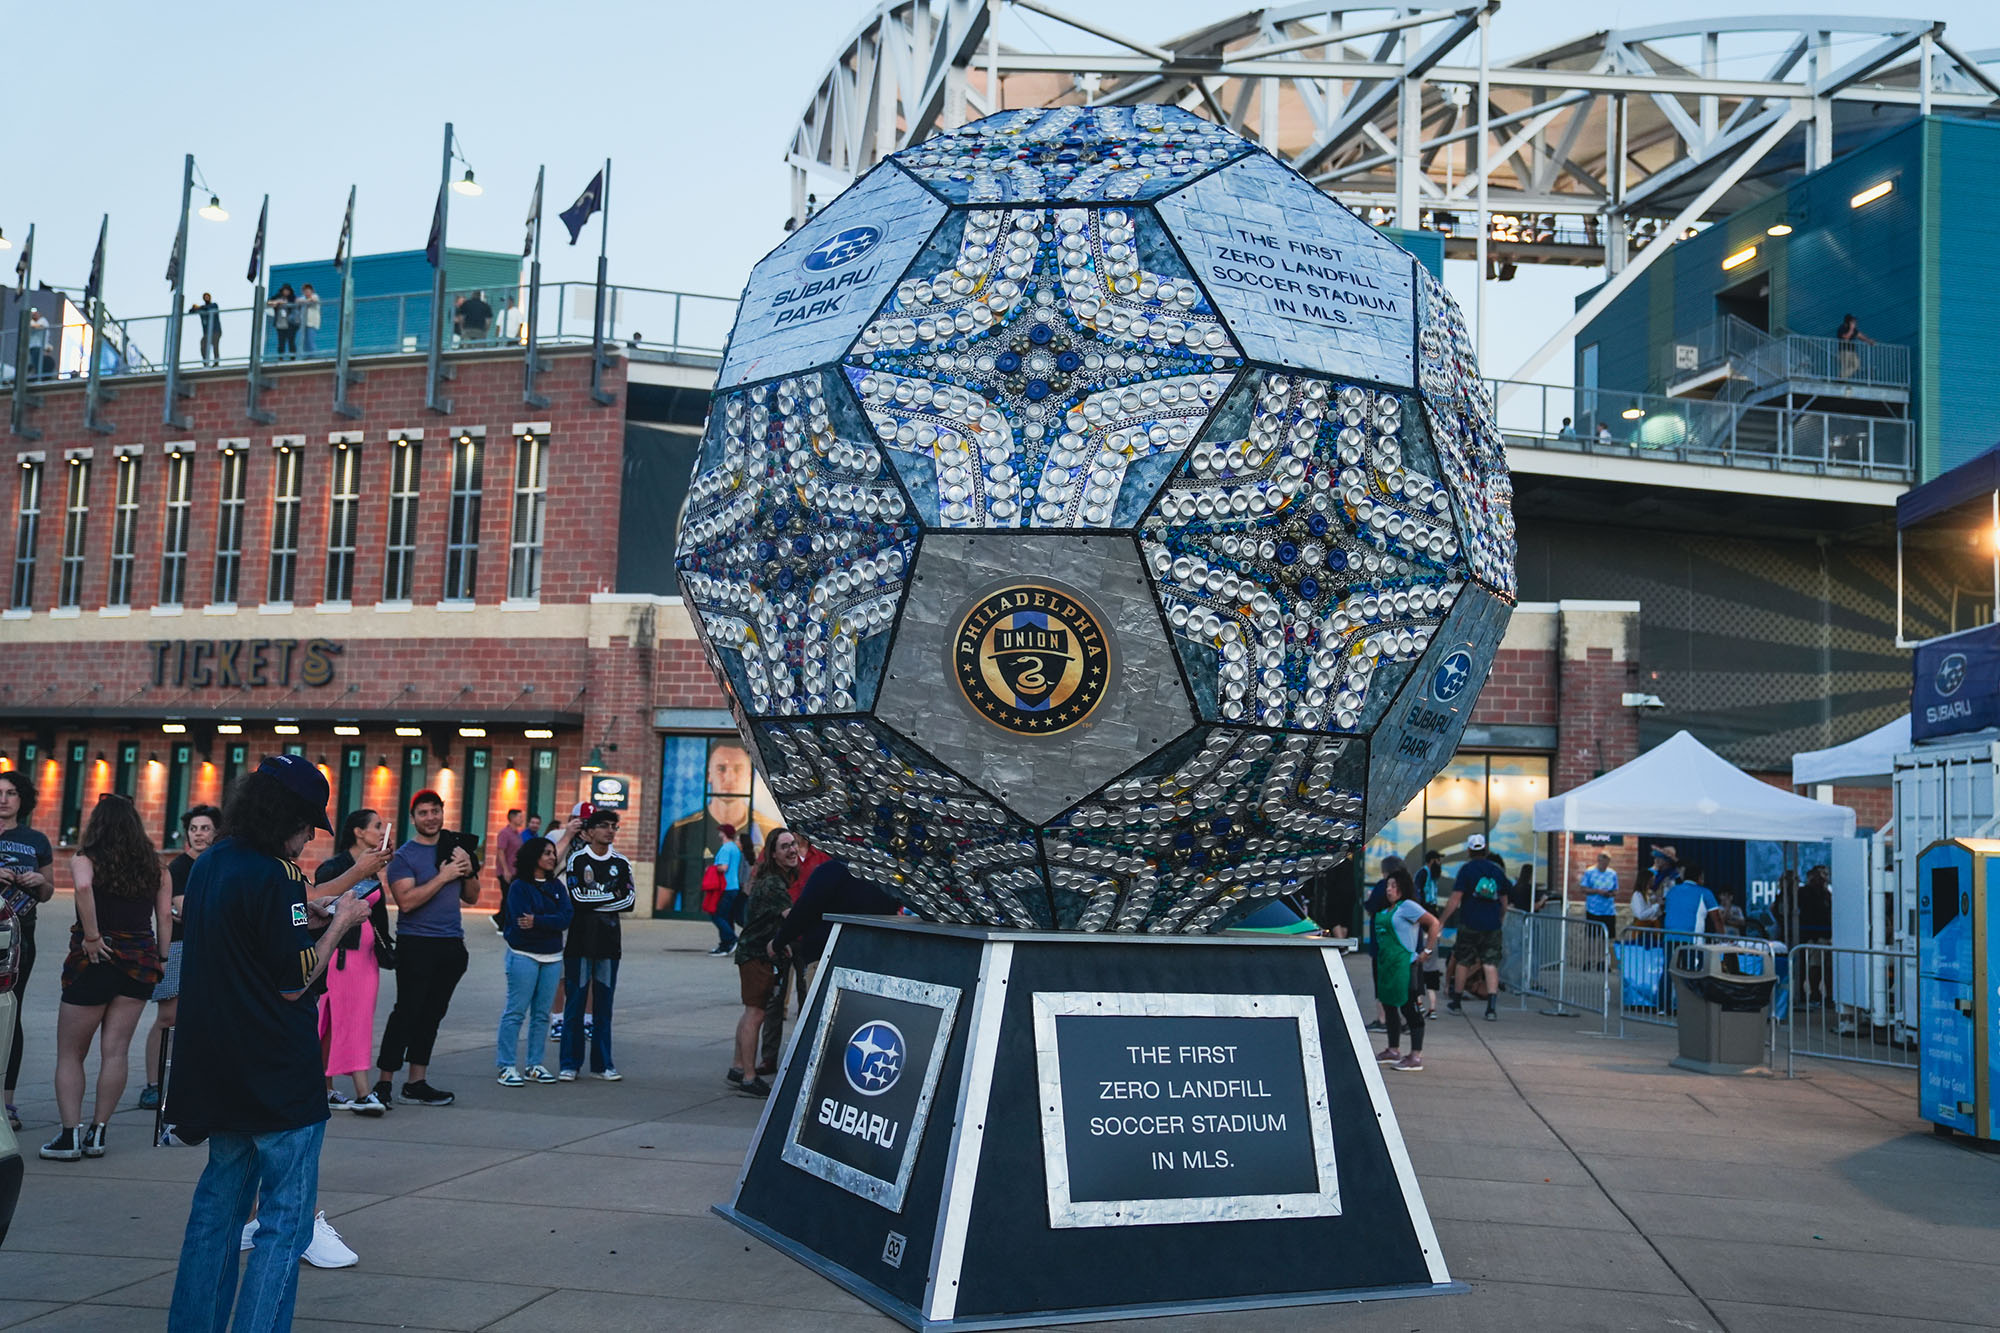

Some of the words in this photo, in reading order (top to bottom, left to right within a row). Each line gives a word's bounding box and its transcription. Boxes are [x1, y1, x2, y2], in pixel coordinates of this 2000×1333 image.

[1236, 229, 1281, 250] THE
[1288, 240, 1343, 262] FIRST
[1216, 246, 1275, 269] ZERO
[1281, 258, 1380, 289] LANDFILL
[771, 265, 875, 308] SUBARU
[1212, 266, 1303, 295] SOCCER
[1307, 284, 1397, 313] STADIUM
[773, 294, 847, 328] PARK
[1273, 297, 1297, 314] IN
[1303, 303, 1353, 325] MLS.
[960, 592, 1103, 658] PHILADELPHIA
[1003, 631, 1059, 649] UNION
[148, 638, 344, 688] TICKETS
[1406, 705, 1453, 735] SUBARU
[1398, 735, 1433, 759] PARK
[1126, 1046, 1172, 1064] THE
[1179, 1046, 1238, 1064] FIRST
[1099, 1081, 1160, 1100] ZERO
[1168, 1080, 1272, 1099] LANDFILL
[818, 1097, 899, 1149] SUBARU
[1090, 1116, 1185, 1136] SOCCER
[1191, 1114, 1287, 1134] STADIUM
[1152, 1151, 1174, 1170] IN
[1182, 1150, 1235, 1169] MLS.
